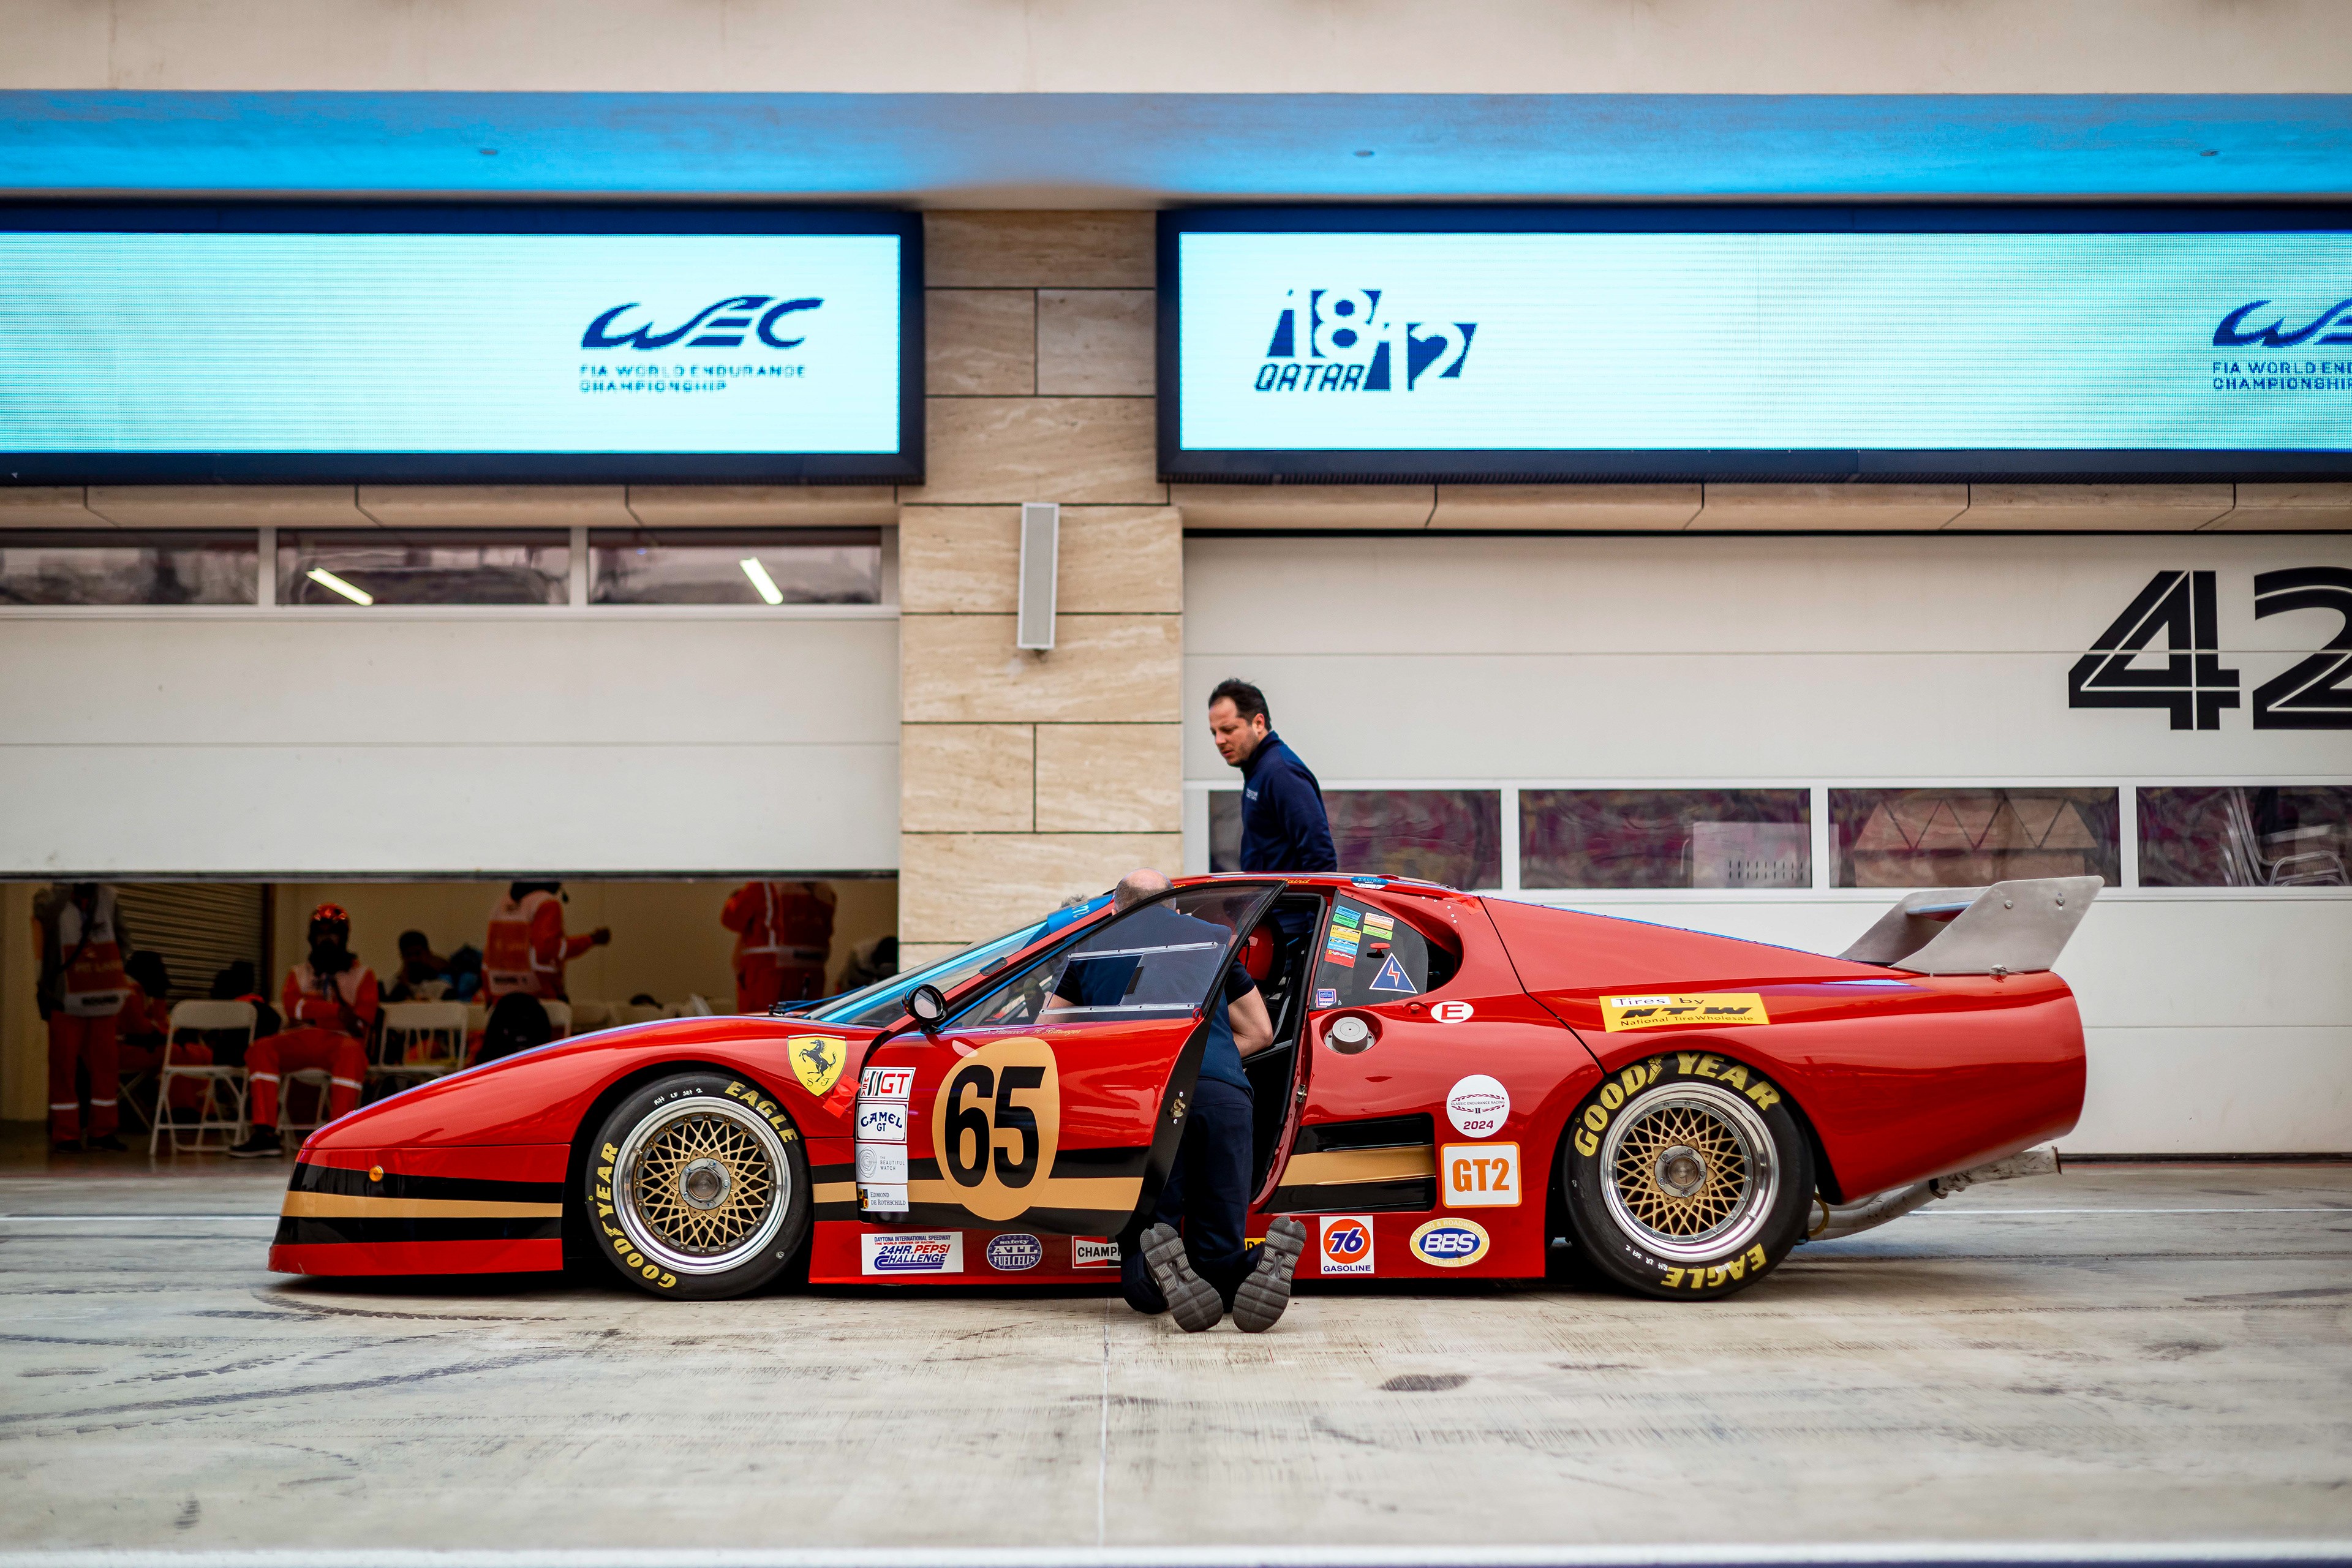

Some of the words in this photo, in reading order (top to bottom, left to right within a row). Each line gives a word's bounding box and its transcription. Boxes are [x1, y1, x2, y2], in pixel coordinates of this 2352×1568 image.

[581, 295, 824, 349] WEC
[580, 364, 608, 378] FIA
[615, 364, 685, 378] WORLD
[690, 364, 807, 378] ENDURANCE
[2213, 361, 2241, 374] FIA
[2248, 361, 2316, 374] WORLD
[1254, 363, 1365, 391] QATAR
[580, 380, 728, 393] CHAMPIONSHIP
[2068, 566, 2352, 730] 42
[1441, 1005, 1464, 1020] E
[1619, 1007, 1753, 1019] NTW
[1621, 1017, 1668, 1027] National
[880, 1073, 910, 1094] GT
[725, 1081, 798, 1143] EAGLE
[861, 1112, 902, 1129] CAMEL
[876, 1123, 886, 1131] GT
[944, 1065, 1047, 1189] 65
[1463, 1120, 1494, 1129] 2024
[1452, 1158, 1510, 1192] GT2
[1412, 1223, 1435, 1242] RACING
[1443, 1219, 1487, 1243] ROADWHEELS
[1329, 1227, 1365, 1254] 76
[1424, 1234, 1476, 1252] BBS
[992, 1245, 1038, 1255] ATL
[874, 1254, 948, 1271] CHALLENGE
[993, 1256, 1012, 1266] FUEL
[1012, 1255, 1036, 1266] CELLS
[1423, 1256, 1459, 1265] INTERMAG
[1660, 1243, 1767, 1291] EAGLE
